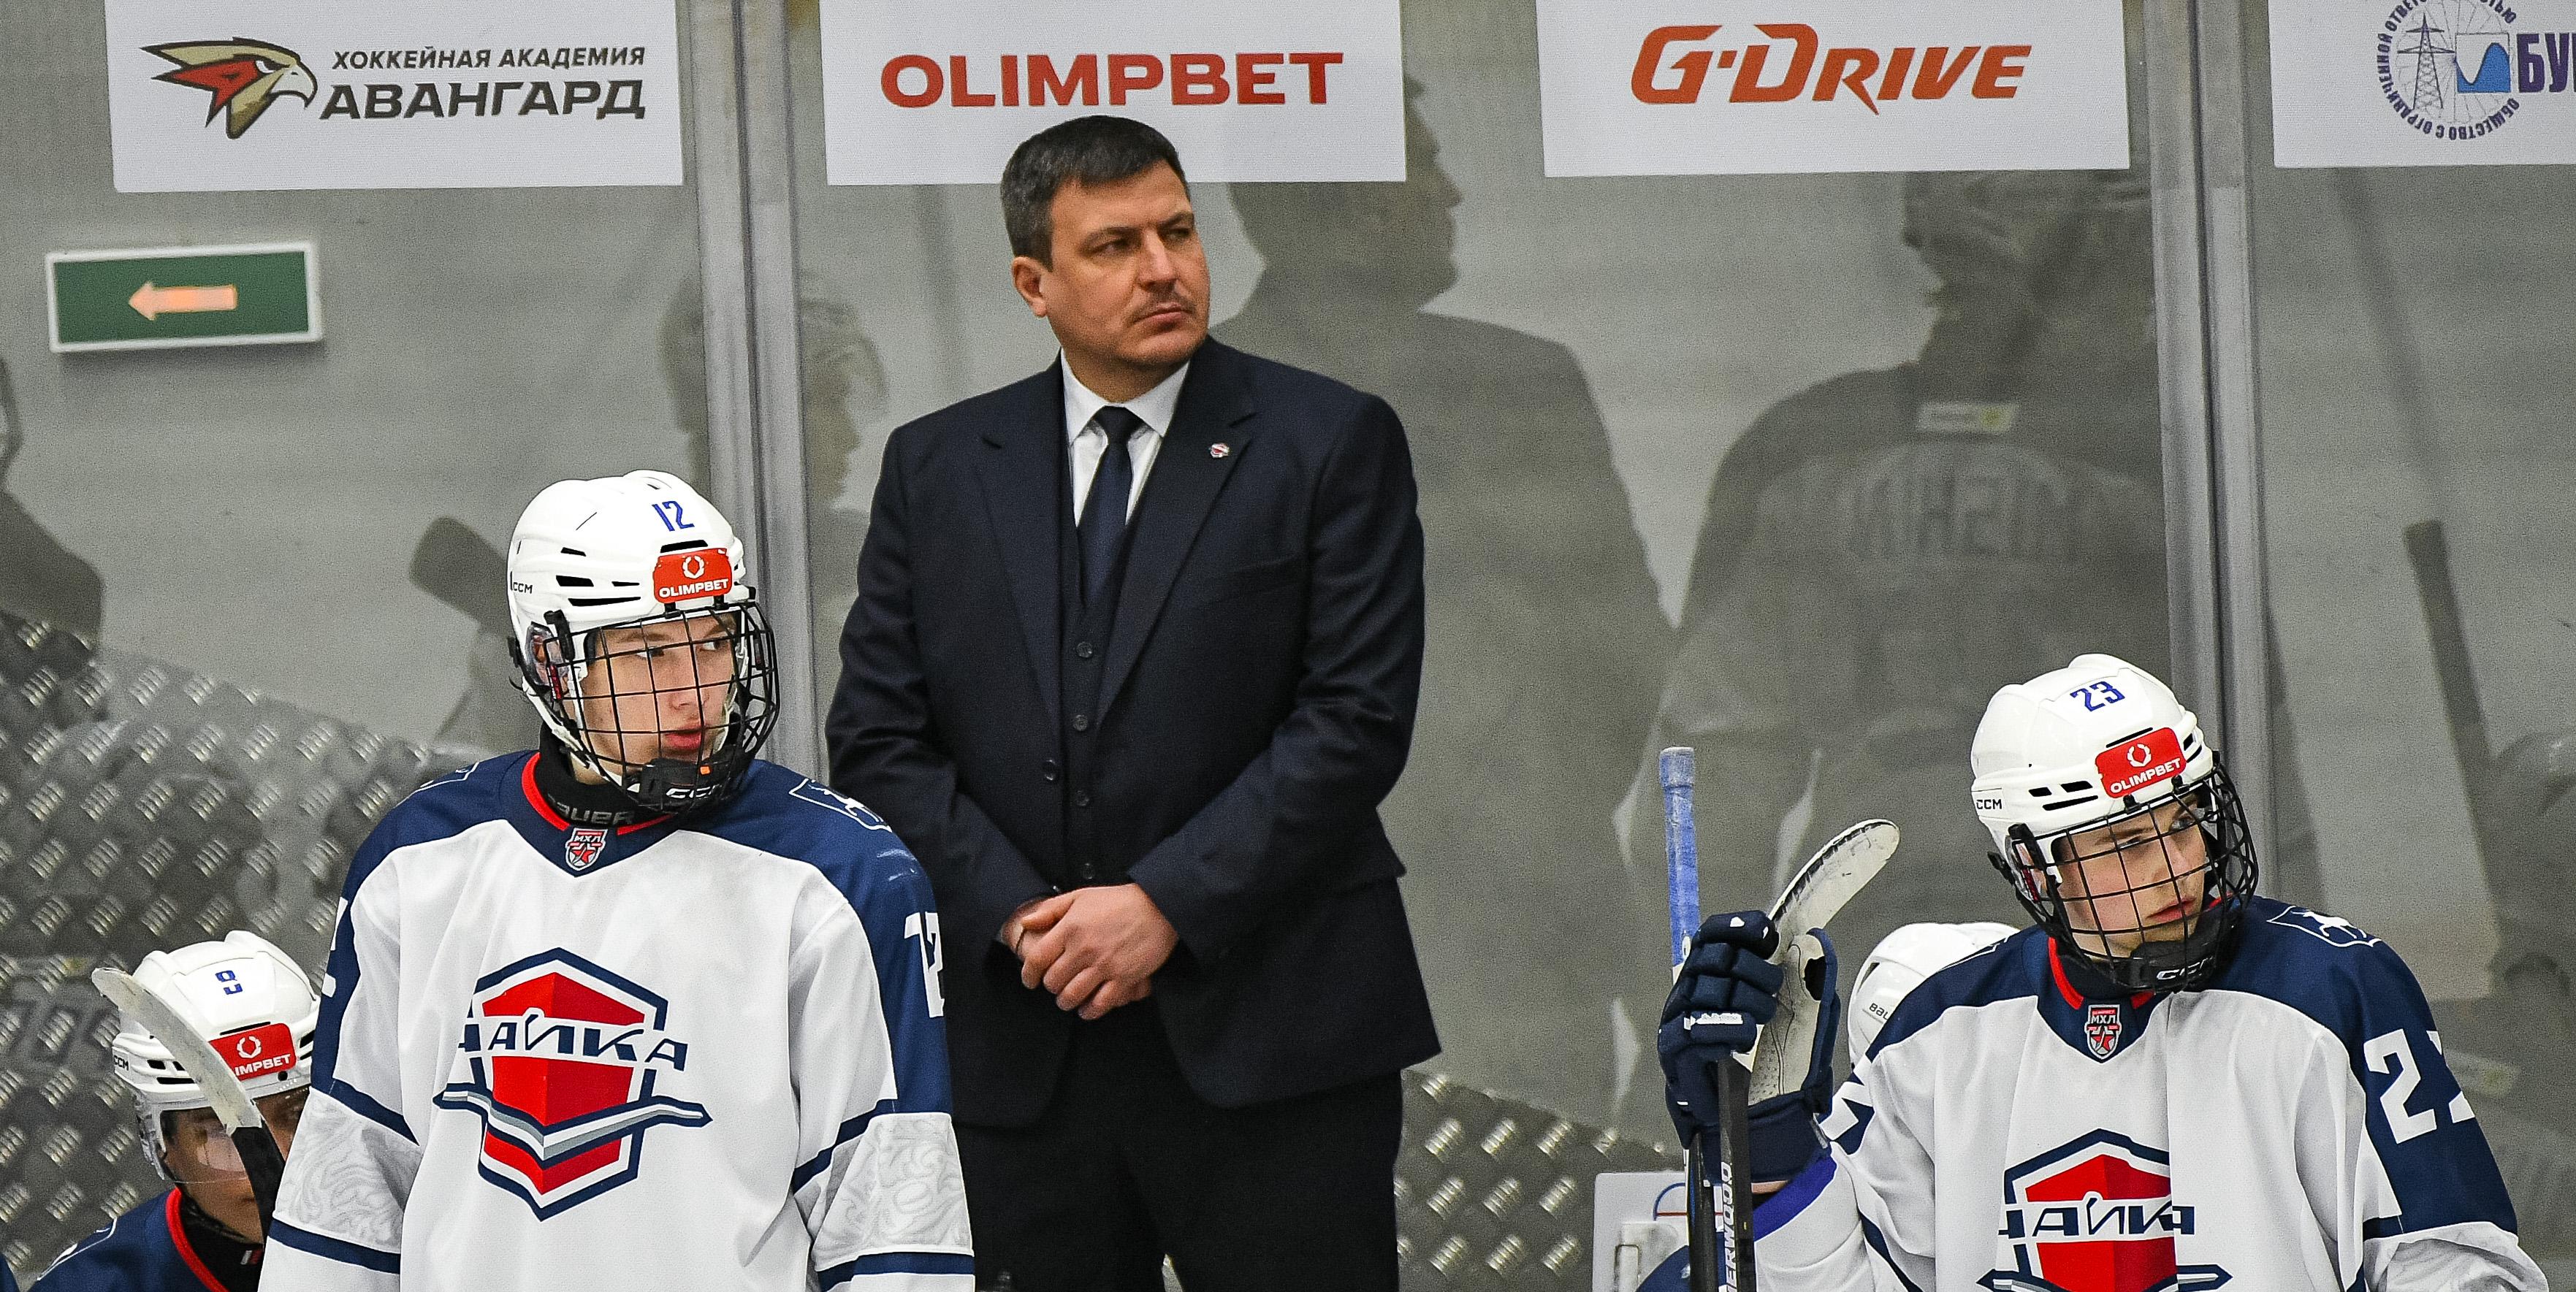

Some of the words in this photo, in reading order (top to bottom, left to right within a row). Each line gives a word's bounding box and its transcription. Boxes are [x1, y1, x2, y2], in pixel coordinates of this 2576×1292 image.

[332, 46, 491, 69] ХОККЕЙНАЯ
[497, 47, 645, 69] АКАДЕМИЯ
[880, 52, 1344, 108] OLIMPBET
[319, 80, 645, 120] АВАНГАРД
[2448, 97, 2520, 140] ОБЩЕСТВО
[652, 501, 695, 532] 12
[513, 581, 533, 594] CCM
[659, 578, 729, 597] OLIMPBET
[2070, 681, 2125, 712] 23
[2110, 757, 2181, 794] OLIMPBET
[547, 793, 635, 825] AUER
[1975, 798, 2003, 810] CCM
[2091, 1014, 2116, 1024] МХЛ
[113, 1055, 129, 1071] CCM
[235, 1054, 291, 1076] IMPBET
